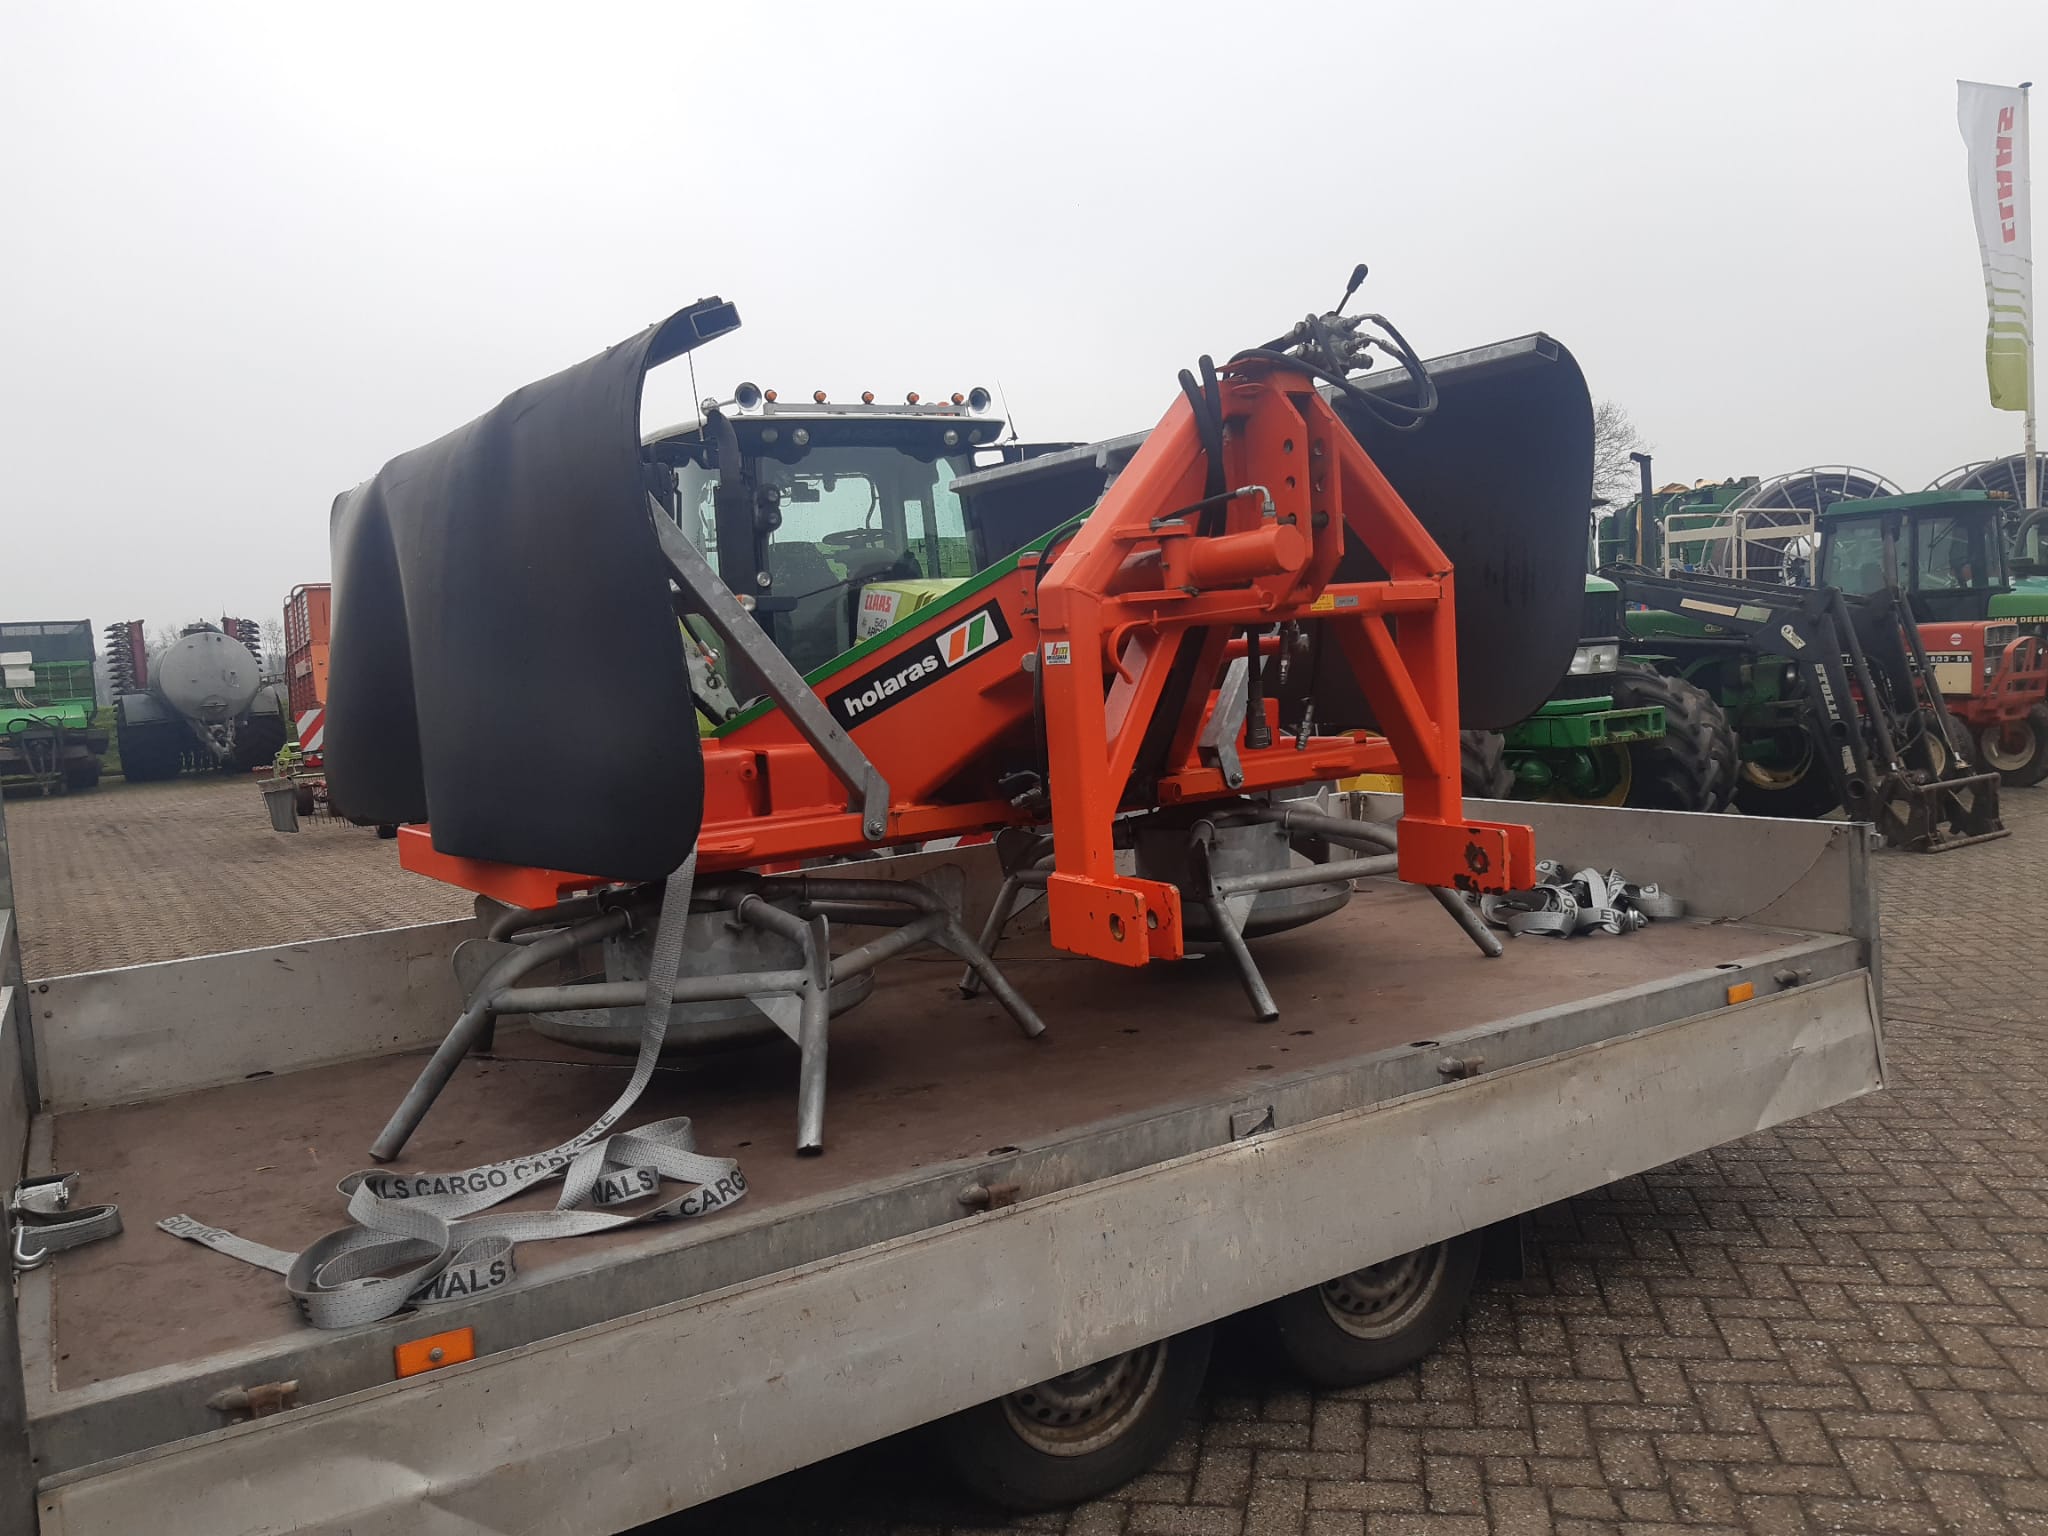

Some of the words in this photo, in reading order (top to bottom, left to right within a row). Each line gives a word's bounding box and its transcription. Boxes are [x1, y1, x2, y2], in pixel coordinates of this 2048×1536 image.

[1996, 105, 2016, 244] CLAAS
[864, 593, 893, 613] CLAAS
[844, 655, 939, 717] holaras
[415, 1169, 508, 1196] CARGO
